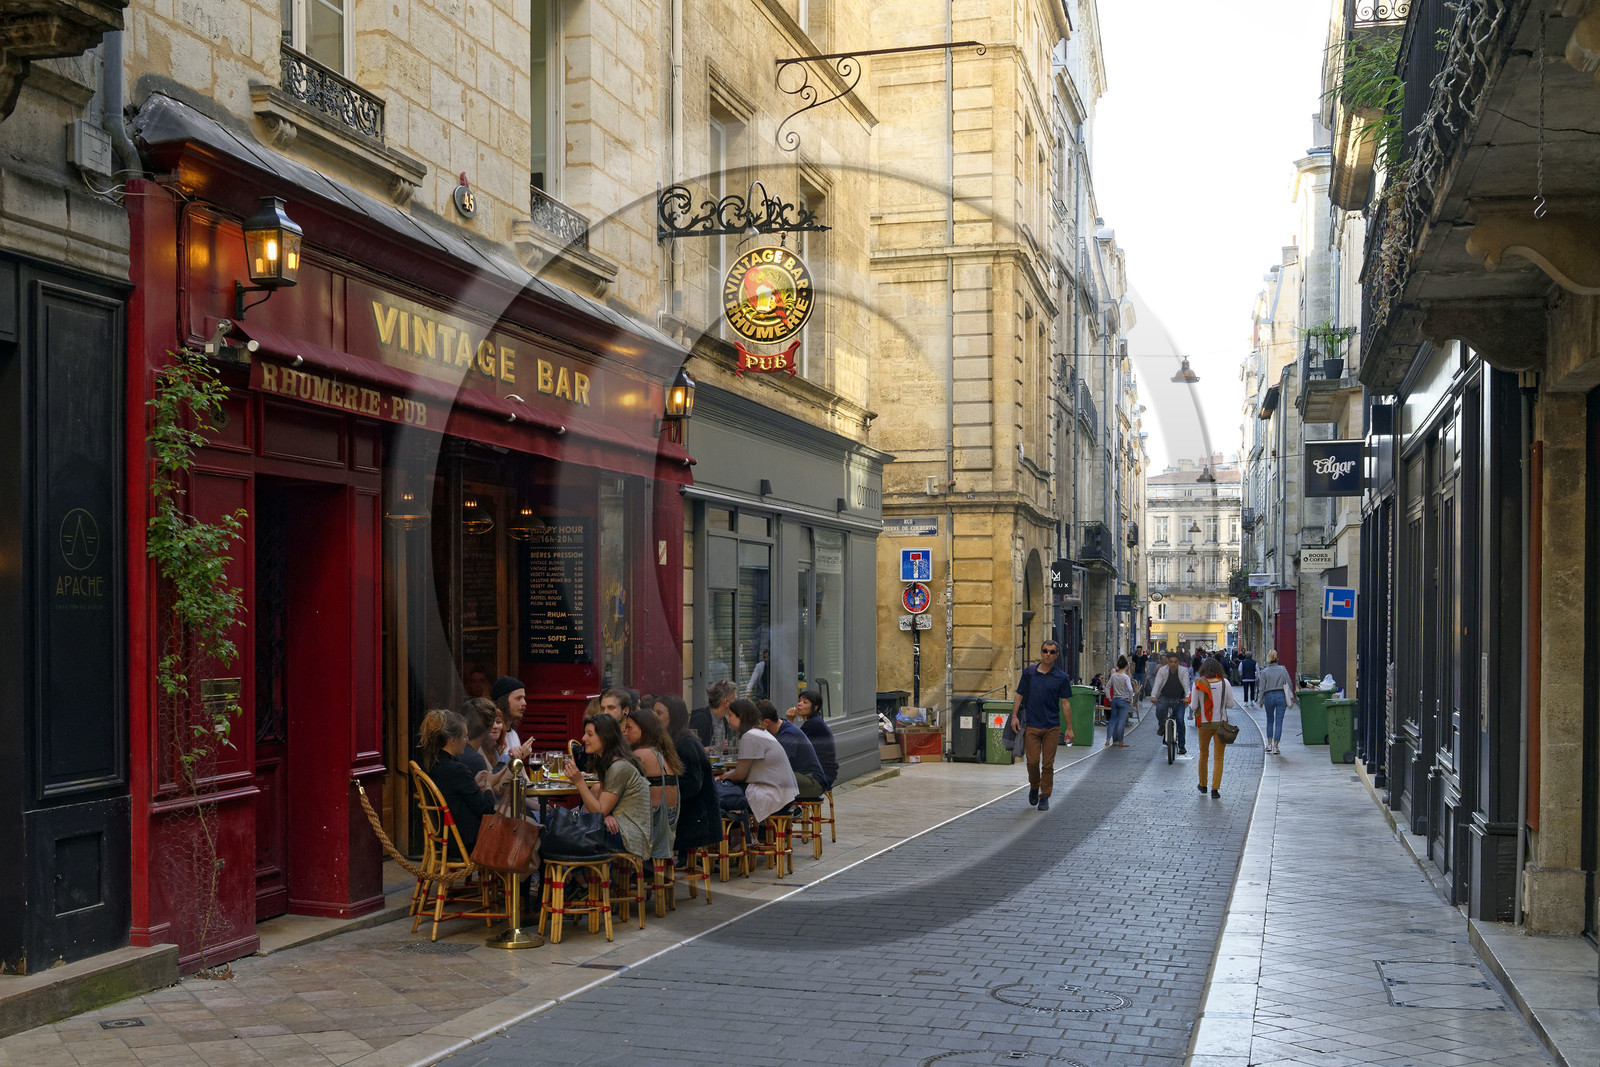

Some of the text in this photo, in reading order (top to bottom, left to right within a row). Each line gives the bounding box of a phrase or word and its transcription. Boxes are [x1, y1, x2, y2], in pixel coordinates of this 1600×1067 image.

[464, 191, 474, 212] 45
[725, 250, 809, 294] VINTAGE BAR
[725, 297, 809, 339] RHUMERIE
[372, 301, 591, 407] VINTAGE BAR
[745, 354, 787, 370] PUB
[261, 362, 427, 426] RHUMERIE PUB
[1313, 456, 1356, 480] Edgar
[558, 526, 584, 534] HOUR
[56, 575, 104, 596] APACHE
